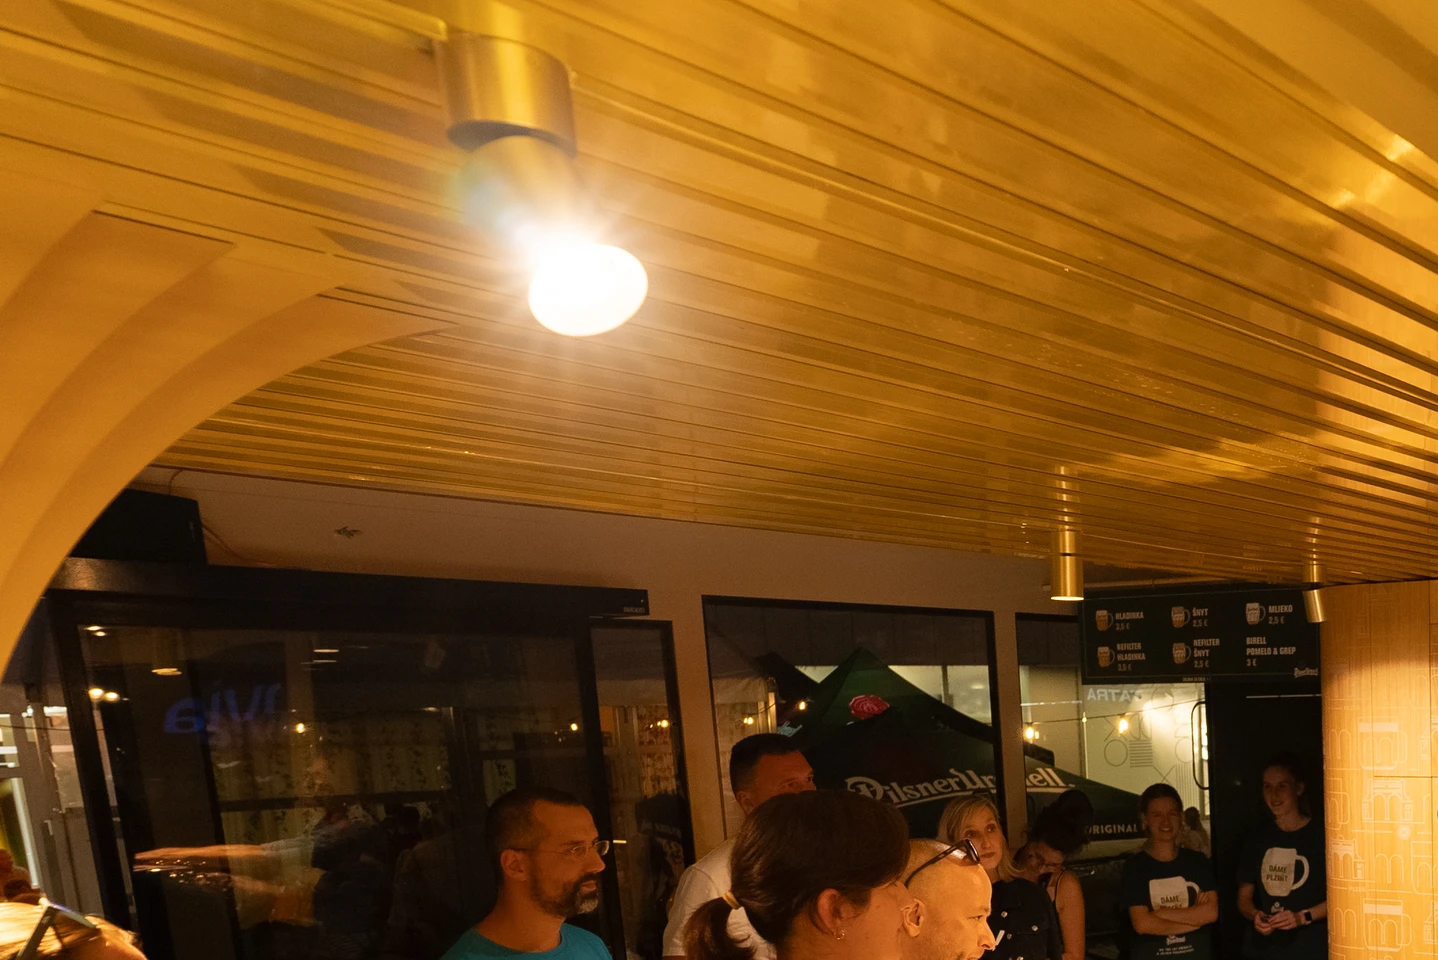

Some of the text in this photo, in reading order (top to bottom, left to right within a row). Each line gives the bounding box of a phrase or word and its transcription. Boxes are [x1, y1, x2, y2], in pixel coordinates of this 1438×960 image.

[1192, 606, 1209, 617] ŠNYT
[1268, 604, 1294, 613] MLIEKO
[1115, 611, 1144, 620] HLADINKA
[1193, 638, 1220, 647] NEFILTER
[1245, 636, 1268, 645] BIRELL
[1193, 647, 1210, 658] ŠNYT
[1246, 647, 1272, 656] POMELO
[1279, 646, 1297, 655] GREP
